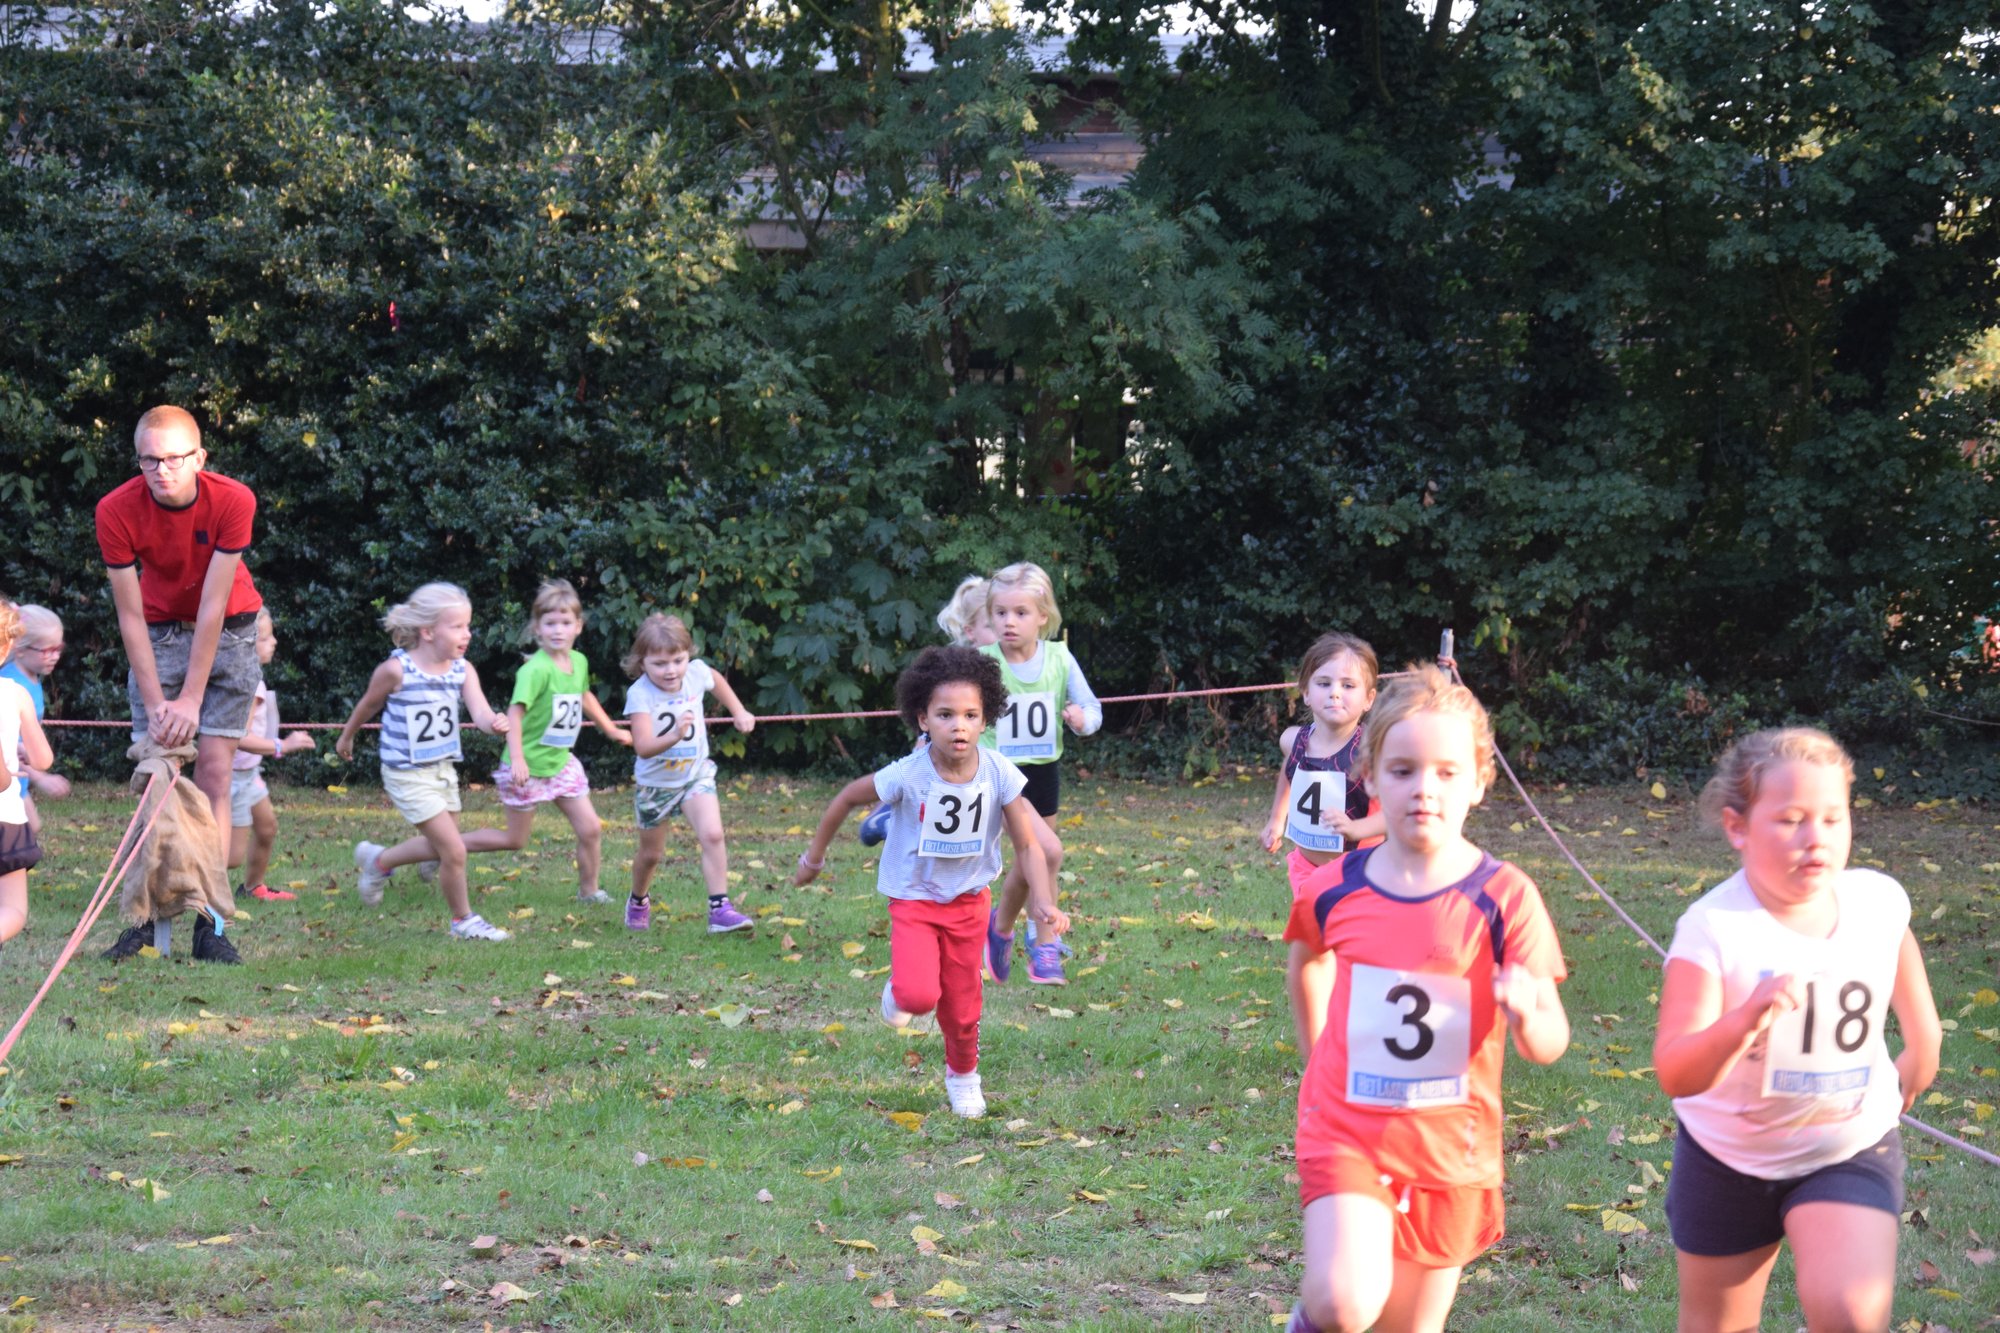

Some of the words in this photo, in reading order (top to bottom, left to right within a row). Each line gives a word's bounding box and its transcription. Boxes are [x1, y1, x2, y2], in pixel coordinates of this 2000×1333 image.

[414, 706, 454, 743] 23
[552, 701, 580, 730] 28
[1002, 701, 1048, 738] 10
[934, 792, 983, 835] 31
[1297, 782, 1324, 825] 4
[1383, 984, 1434, 1061] 3
[1802, 980, 1871, 1054] 18
